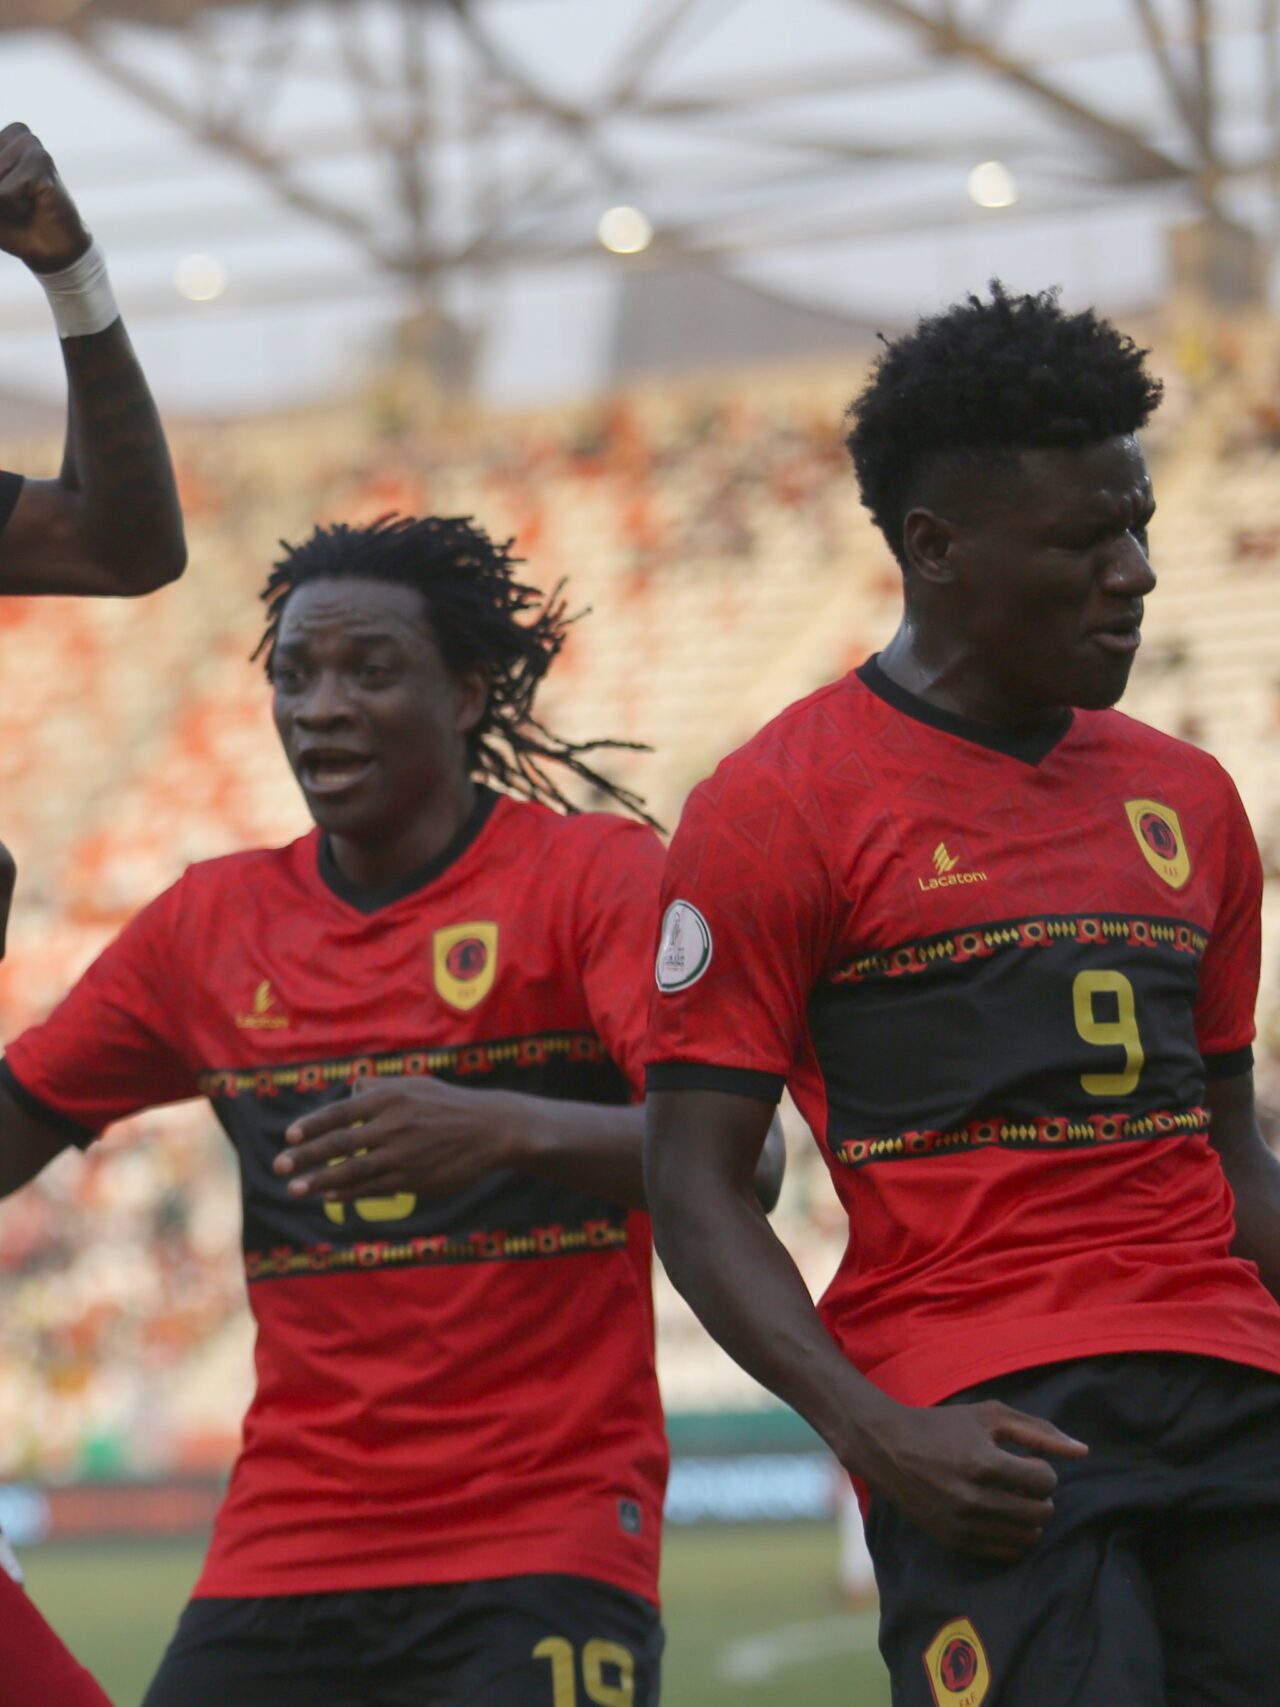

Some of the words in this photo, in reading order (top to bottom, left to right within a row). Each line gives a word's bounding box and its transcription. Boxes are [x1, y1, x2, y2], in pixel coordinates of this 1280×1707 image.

[918, 871, 988, 891] Lacatoni
[1072, 968, 1146, 1097] 9
[532, 1635, 635, 1707] 19
